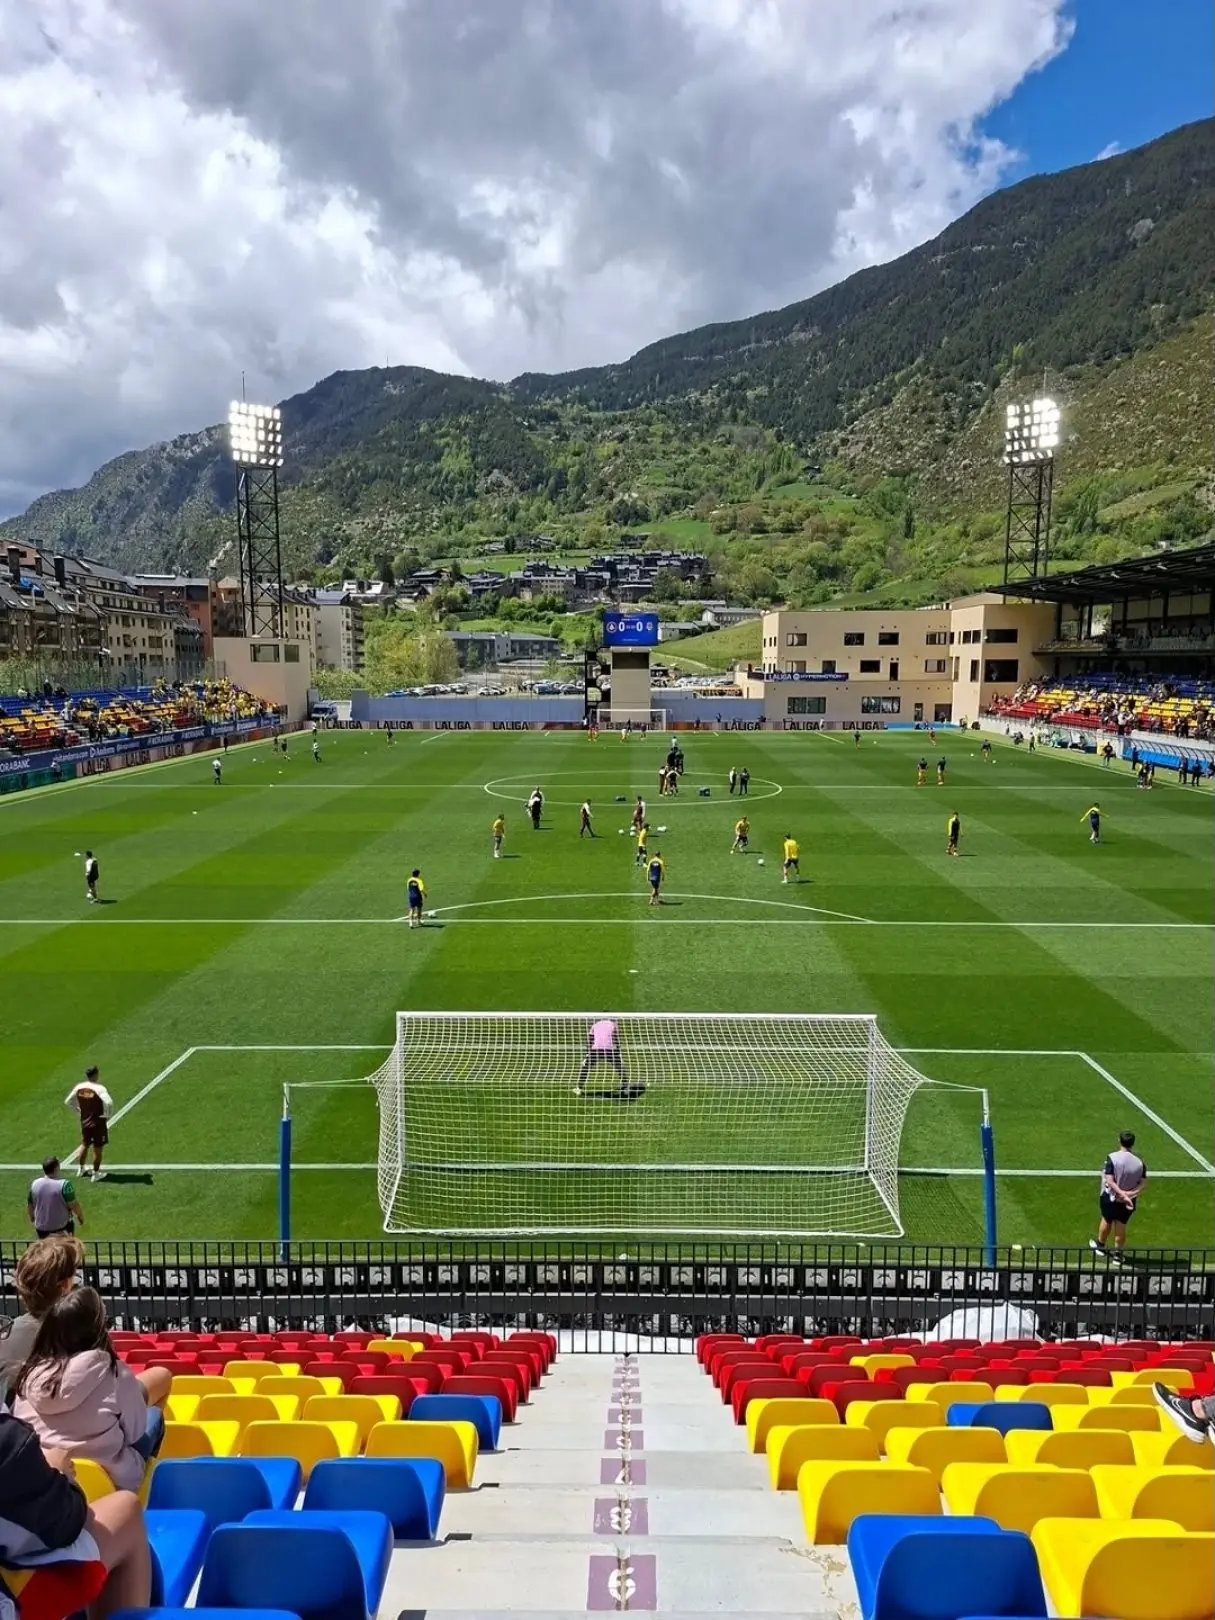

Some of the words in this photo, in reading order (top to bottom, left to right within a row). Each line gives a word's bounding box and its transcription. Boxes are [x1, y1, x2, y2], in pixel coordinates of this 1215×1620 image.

[618, 621, 625, 632] 0
[636, 621, 643, 632] 0
[768, 673, 792, 681] LALIGA
[326, 720, 362, 730] LALIGA
[377, 720, 414, 730] LALIGA
[435, 720, 472, 730] LALIGA
[492, 721, 528, 731] LALIGA
[725, 721, 761, 731] LALIGA
[783, 721, 820, 731] LALIGA
[843, 721, 880, 731] LALIGA
